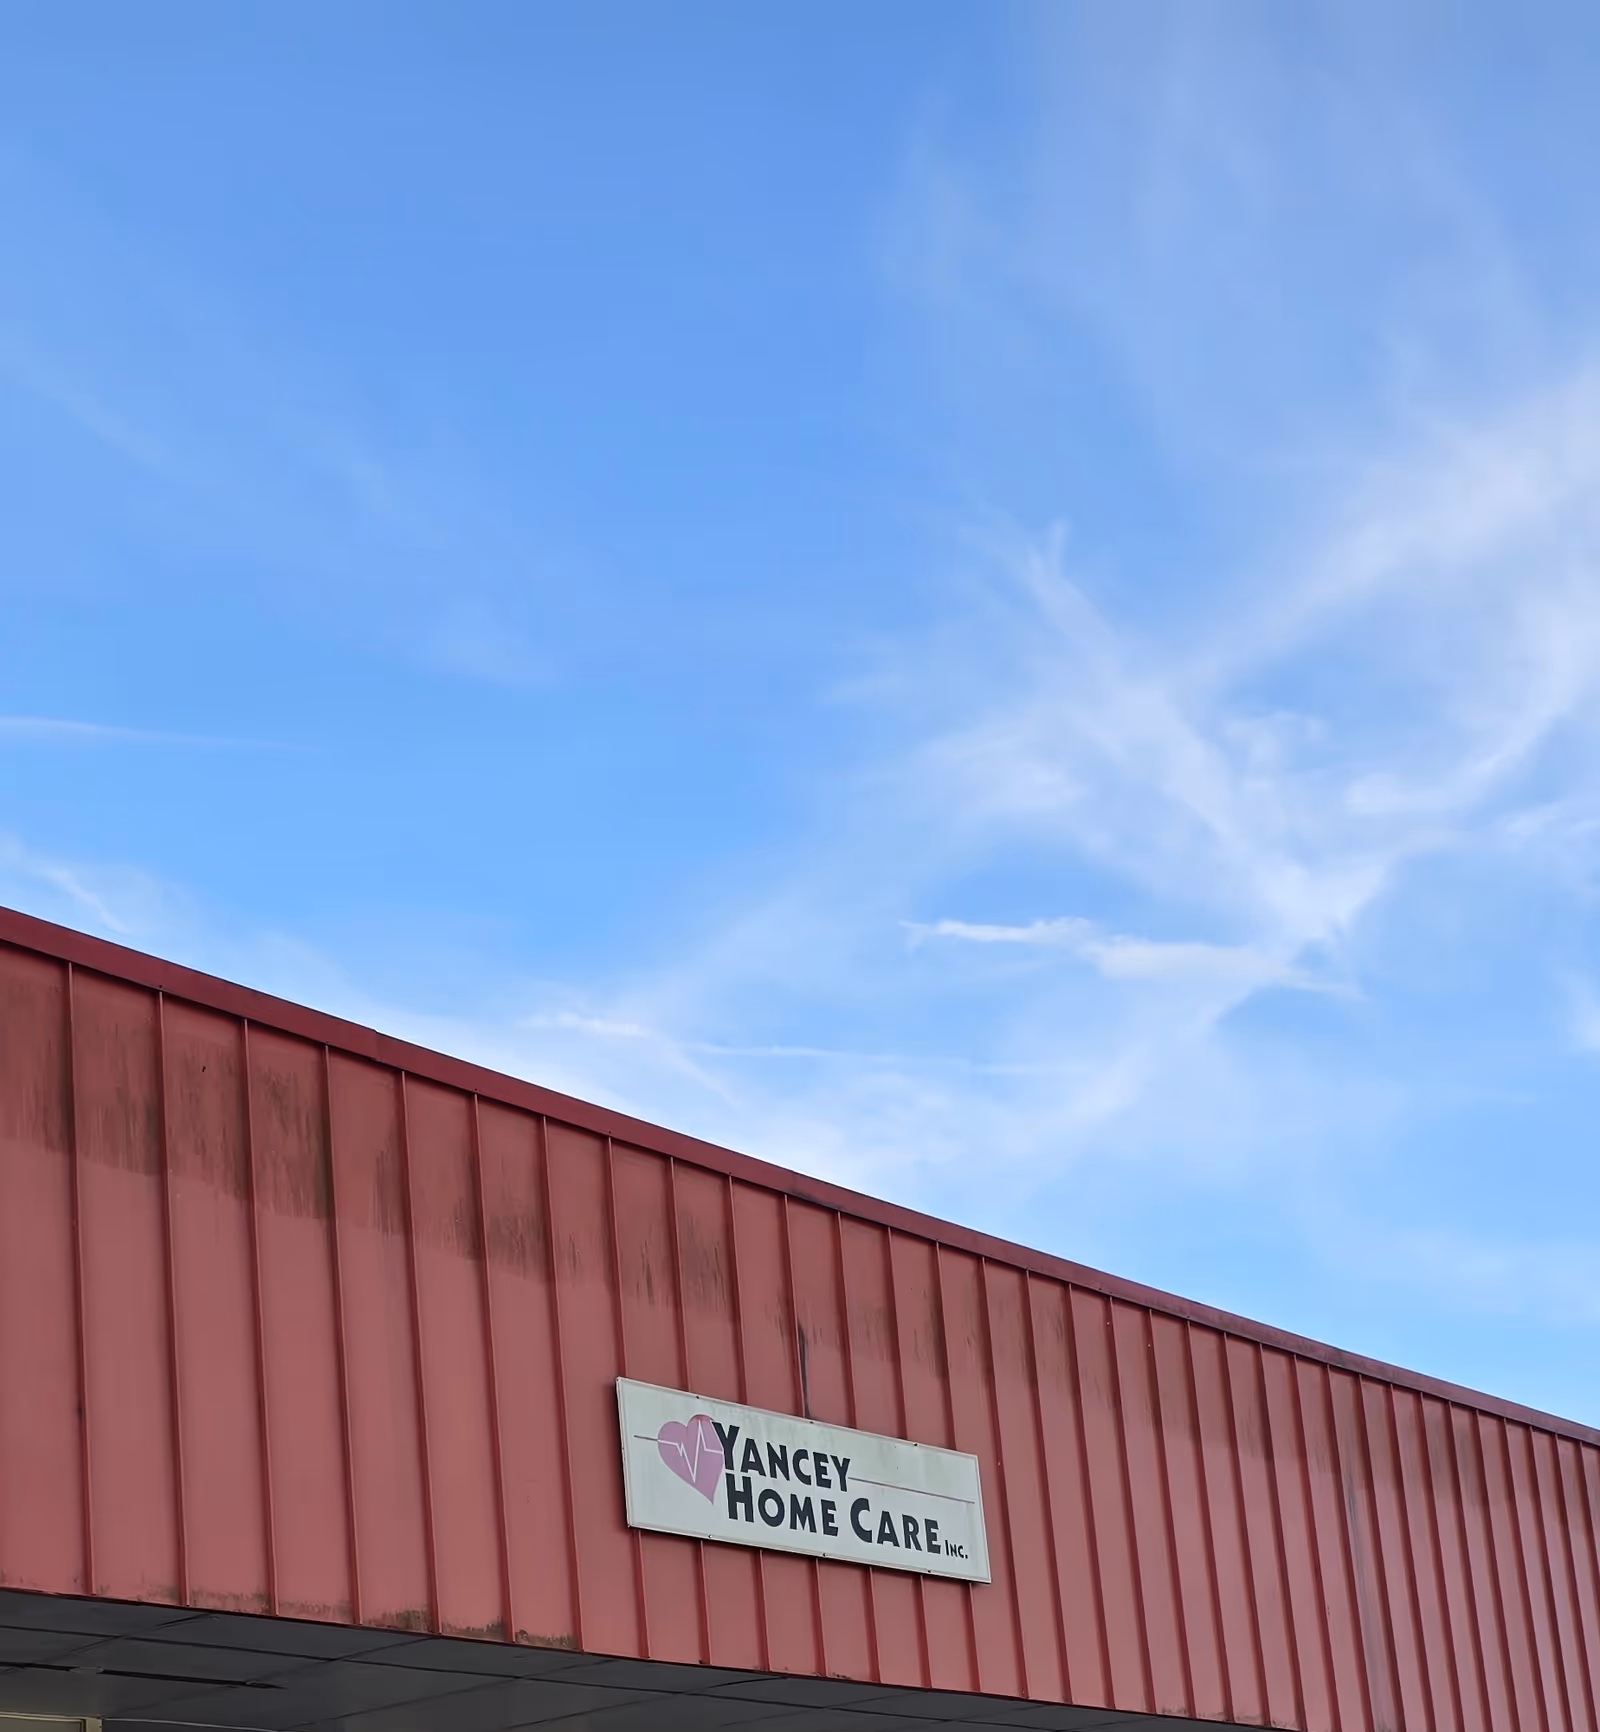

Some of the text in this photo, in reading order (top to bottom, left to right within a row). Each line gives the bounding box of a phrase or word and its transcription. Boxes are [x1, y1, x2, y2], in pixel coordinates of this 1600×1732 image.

[712, 1421, 851, 1492] YANCEY
[725, 1473, 839, 1536] HOME
[850, 1497, 941, 1554] CARE
